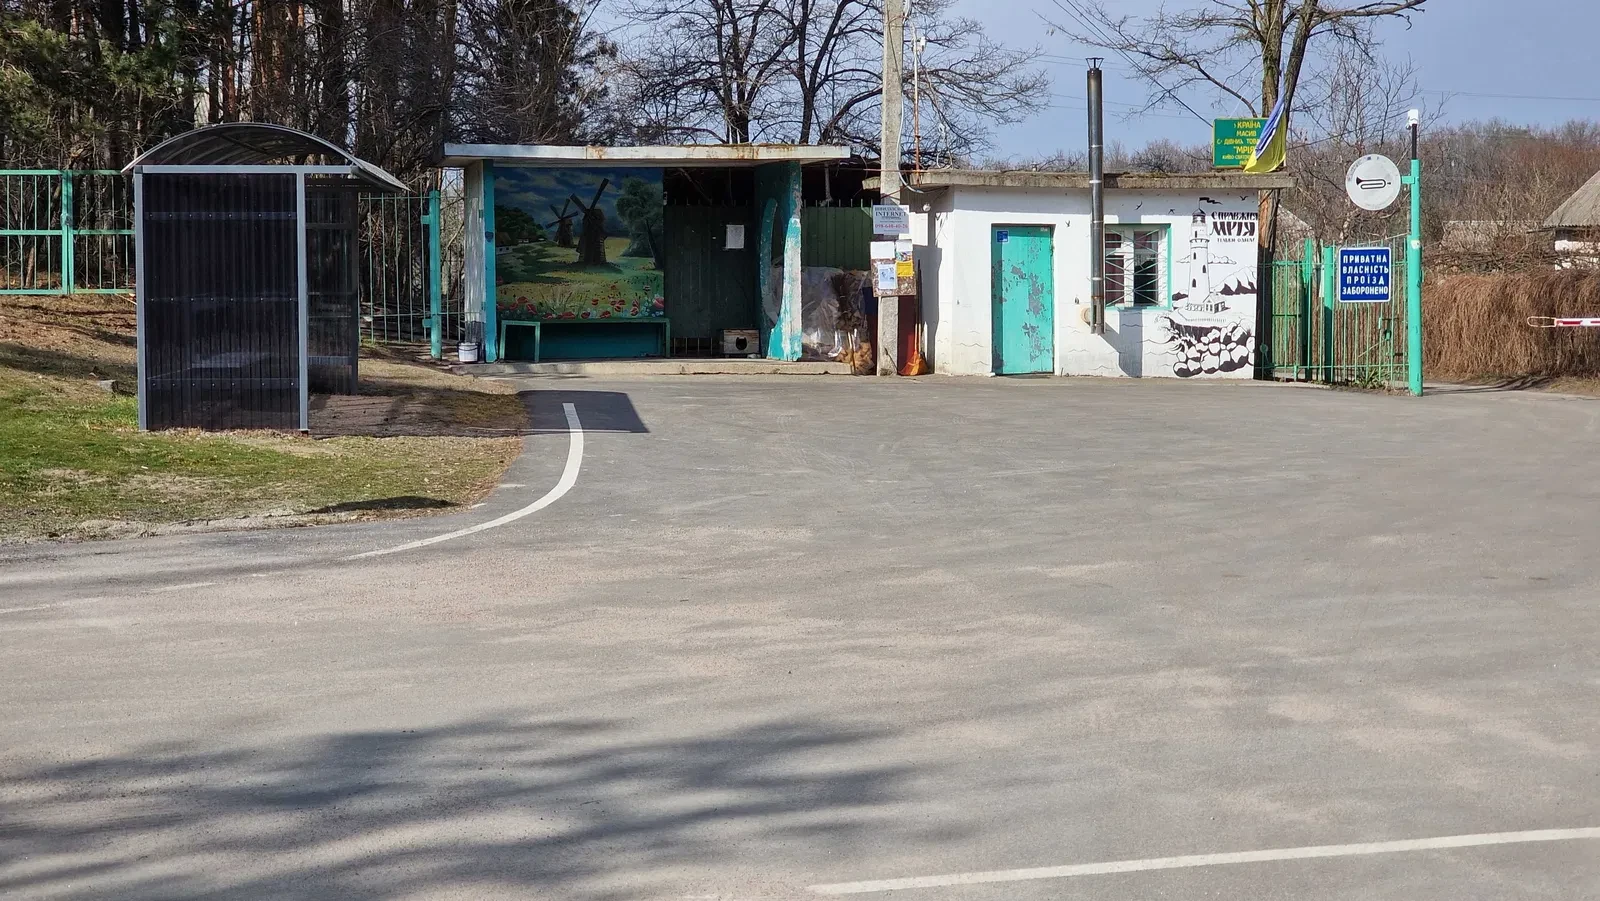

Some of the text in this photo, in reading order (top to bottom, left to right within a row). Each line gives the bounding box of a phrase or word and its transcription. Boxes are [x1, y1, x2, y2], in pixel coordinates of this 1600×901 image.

[1209, 221, 1256, 237] МРІЯ
[1343, 254, 1387, 264] ПРИВАТНА
[1342, 265, 1389, 274] ВЛАСНІСТЬ
[1346, 274, 1385, 285] ПРОЇЗД
[1342, 286, 1389, 295] ЗАБОРОНЕНО
